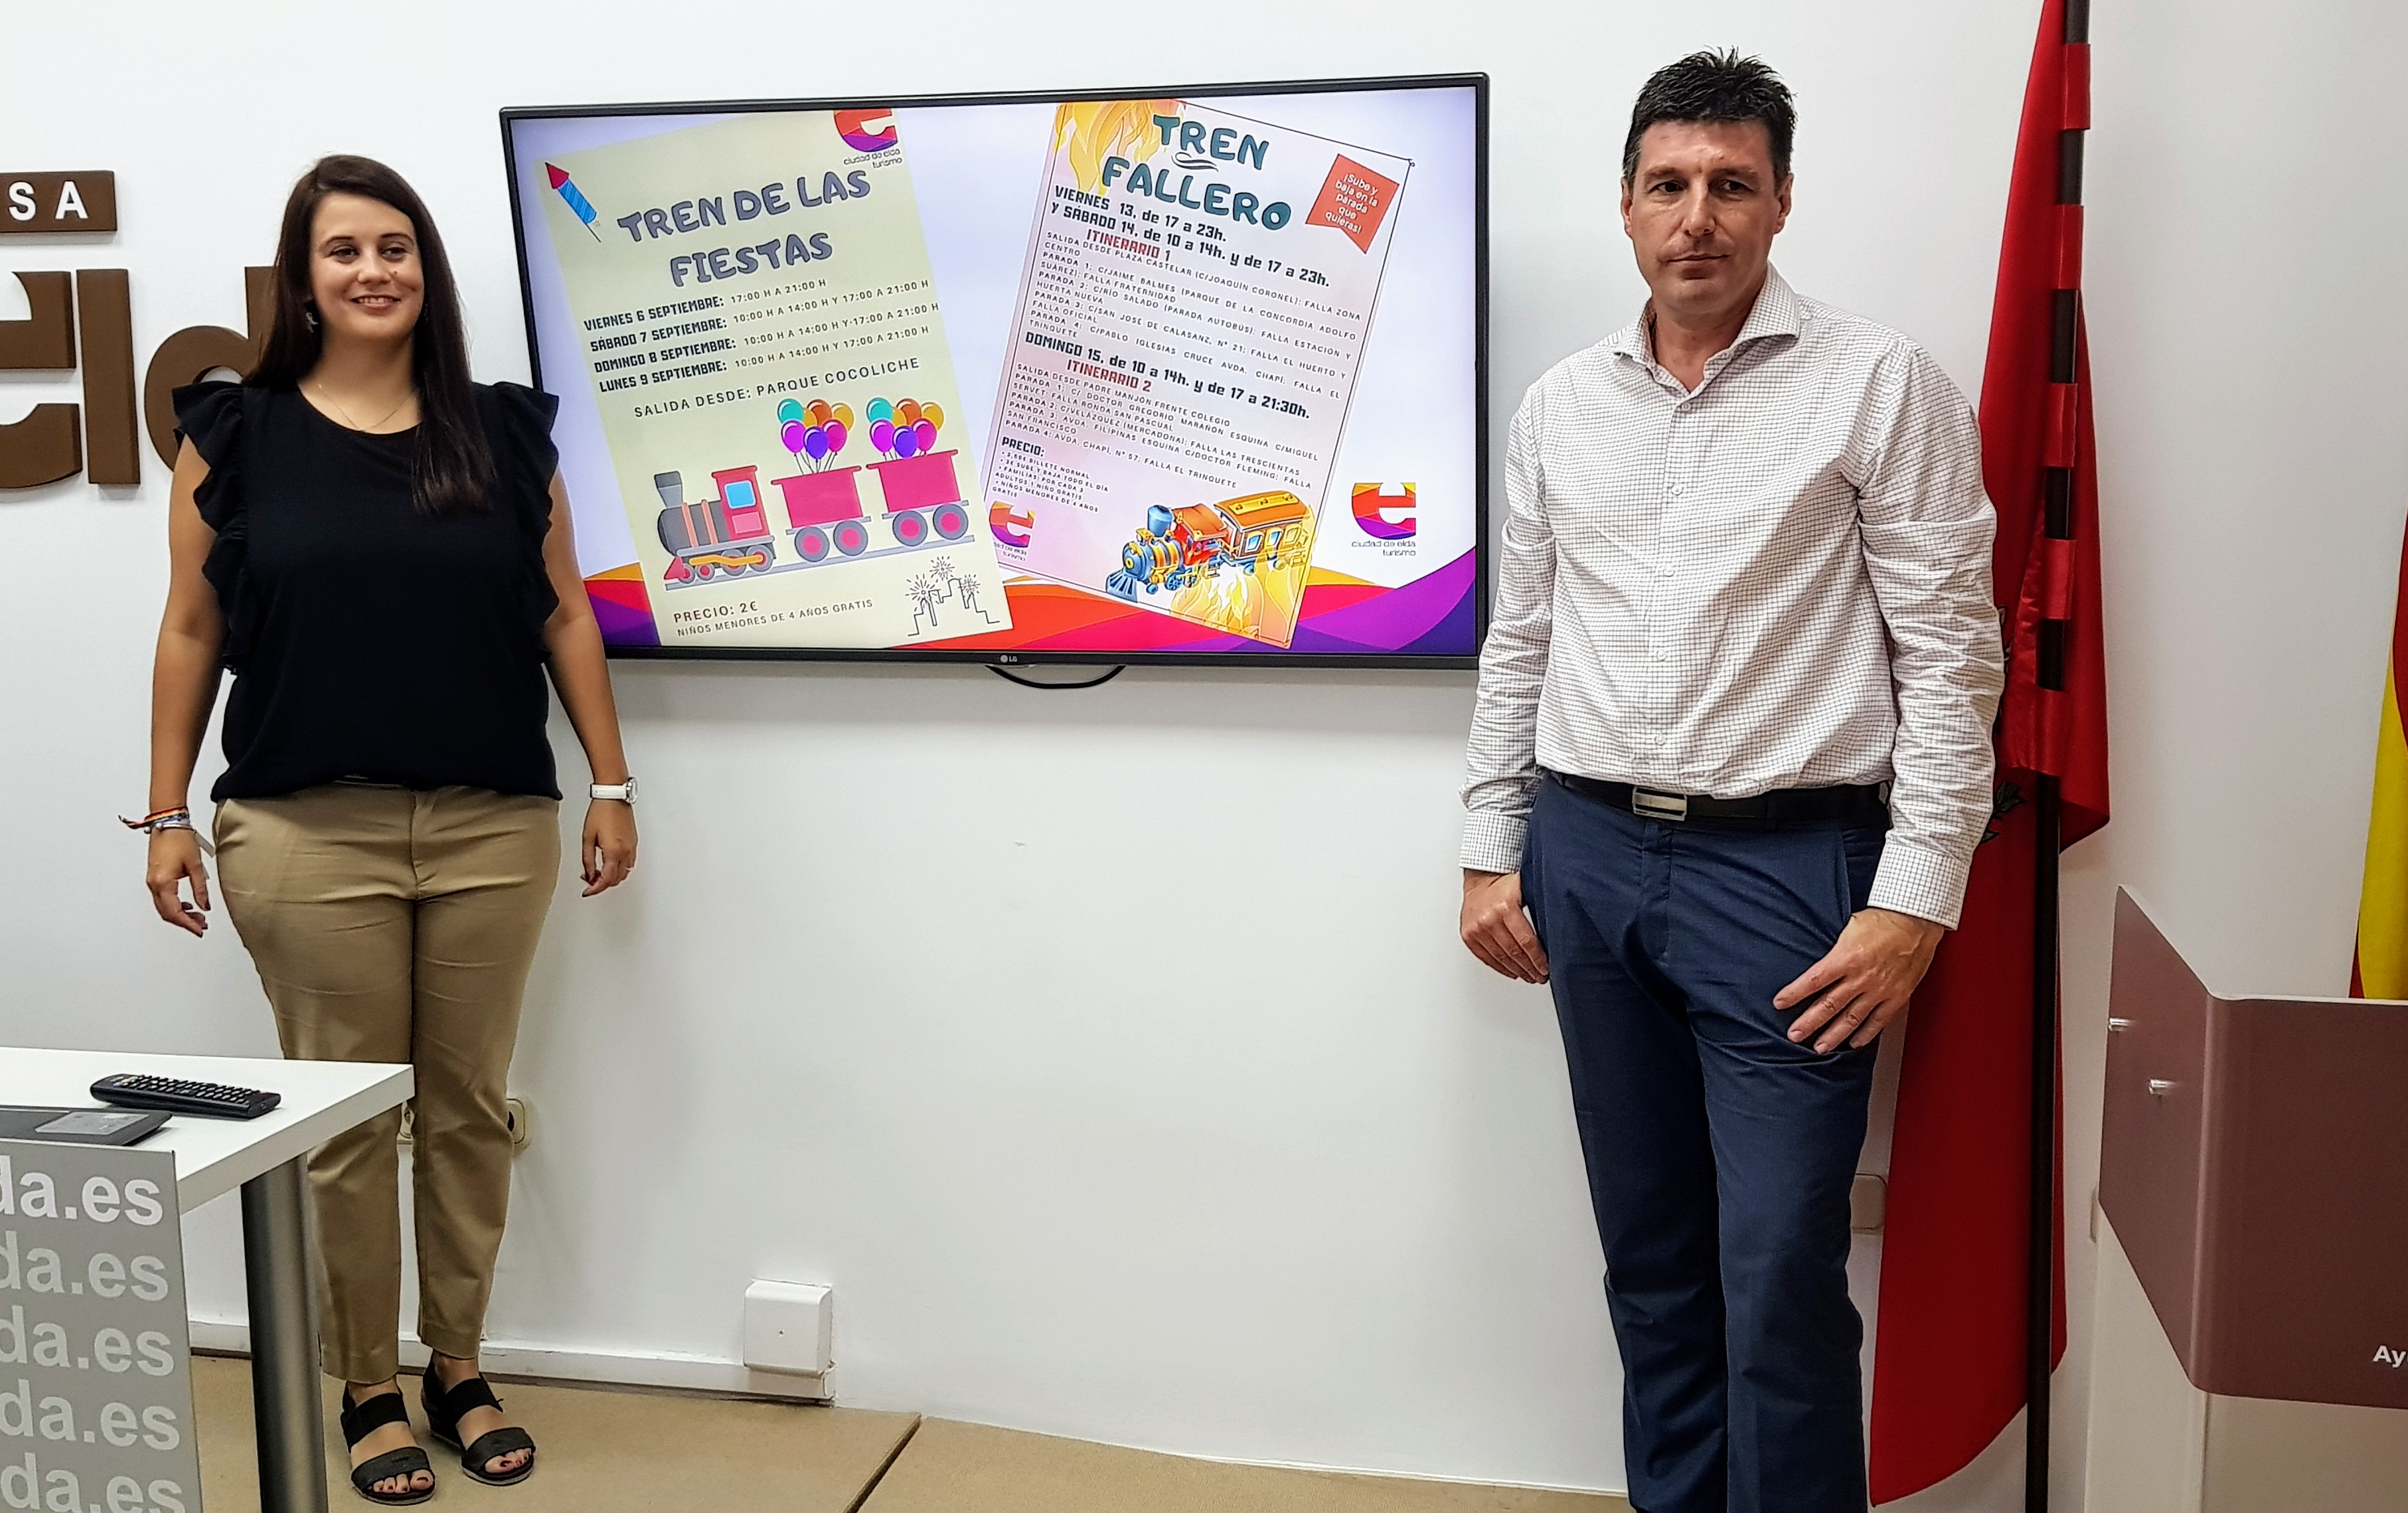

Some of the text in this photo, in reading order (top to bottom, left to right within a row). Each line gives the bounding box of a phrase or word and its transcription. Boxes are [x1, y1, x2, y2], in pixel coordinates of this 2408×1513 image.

[1153, 115, 1270, 171] TREN
[616, 170, 872, 243] TREN DE LAS
[1055, 185, 1226, 242] VIERNES 13, de 17 a 23h.
[1103, 156, 1292, 231] FALLERO
[1335, 179, 1355, 195] baja
[1369, 196, 1378, 207] la
[1335, 193, 1368, 213] parada
[669, 232, 833, 287] FIESTAS
[1062, 204, 1329, 287] SÁBADO 14, de 10 14h. de 17 23h.
[1086, 228, 1170, 262] ITINERARIO 1
[583, 280, 815, 331] VIERNES 6 SEPTIEMBRE: 17:00 21:00
[590, 281, 918, 352] SÁBADO 7 SEPTIEMBRE: 10:00 14:00 17:00 21:00
[594, 304, 927, 373] DOMINGO 8 SEPTIEMBRE: 10:00 14:00 21:00
[598, 327, 918, 392] LUNES 9 SEPTIEMBRE: 10:00 14:00 17:00 21:00
[633, 357, 920, 418] SALIDA DESDE: PARQUE COCOLICHE
[1024, 331, 1309, 419] DOMINGO 15, de 10 a 14h. y de 17 a 21:30h.
[1066, 358, 1152, 392] ITINERARIO 2
[1001, 436, 1044, 457] PRECIO:
[673, 600, 758, 623] PRECIO: 2€
[677, 598, 873, 637] NIÑOS MENORES DE AÑOS GRATIS
[2372, 1345, 2408, 1368] Ay
[0, 1379, 180, 1451] da.es
[1, 1452, 186, 1513] da.es
